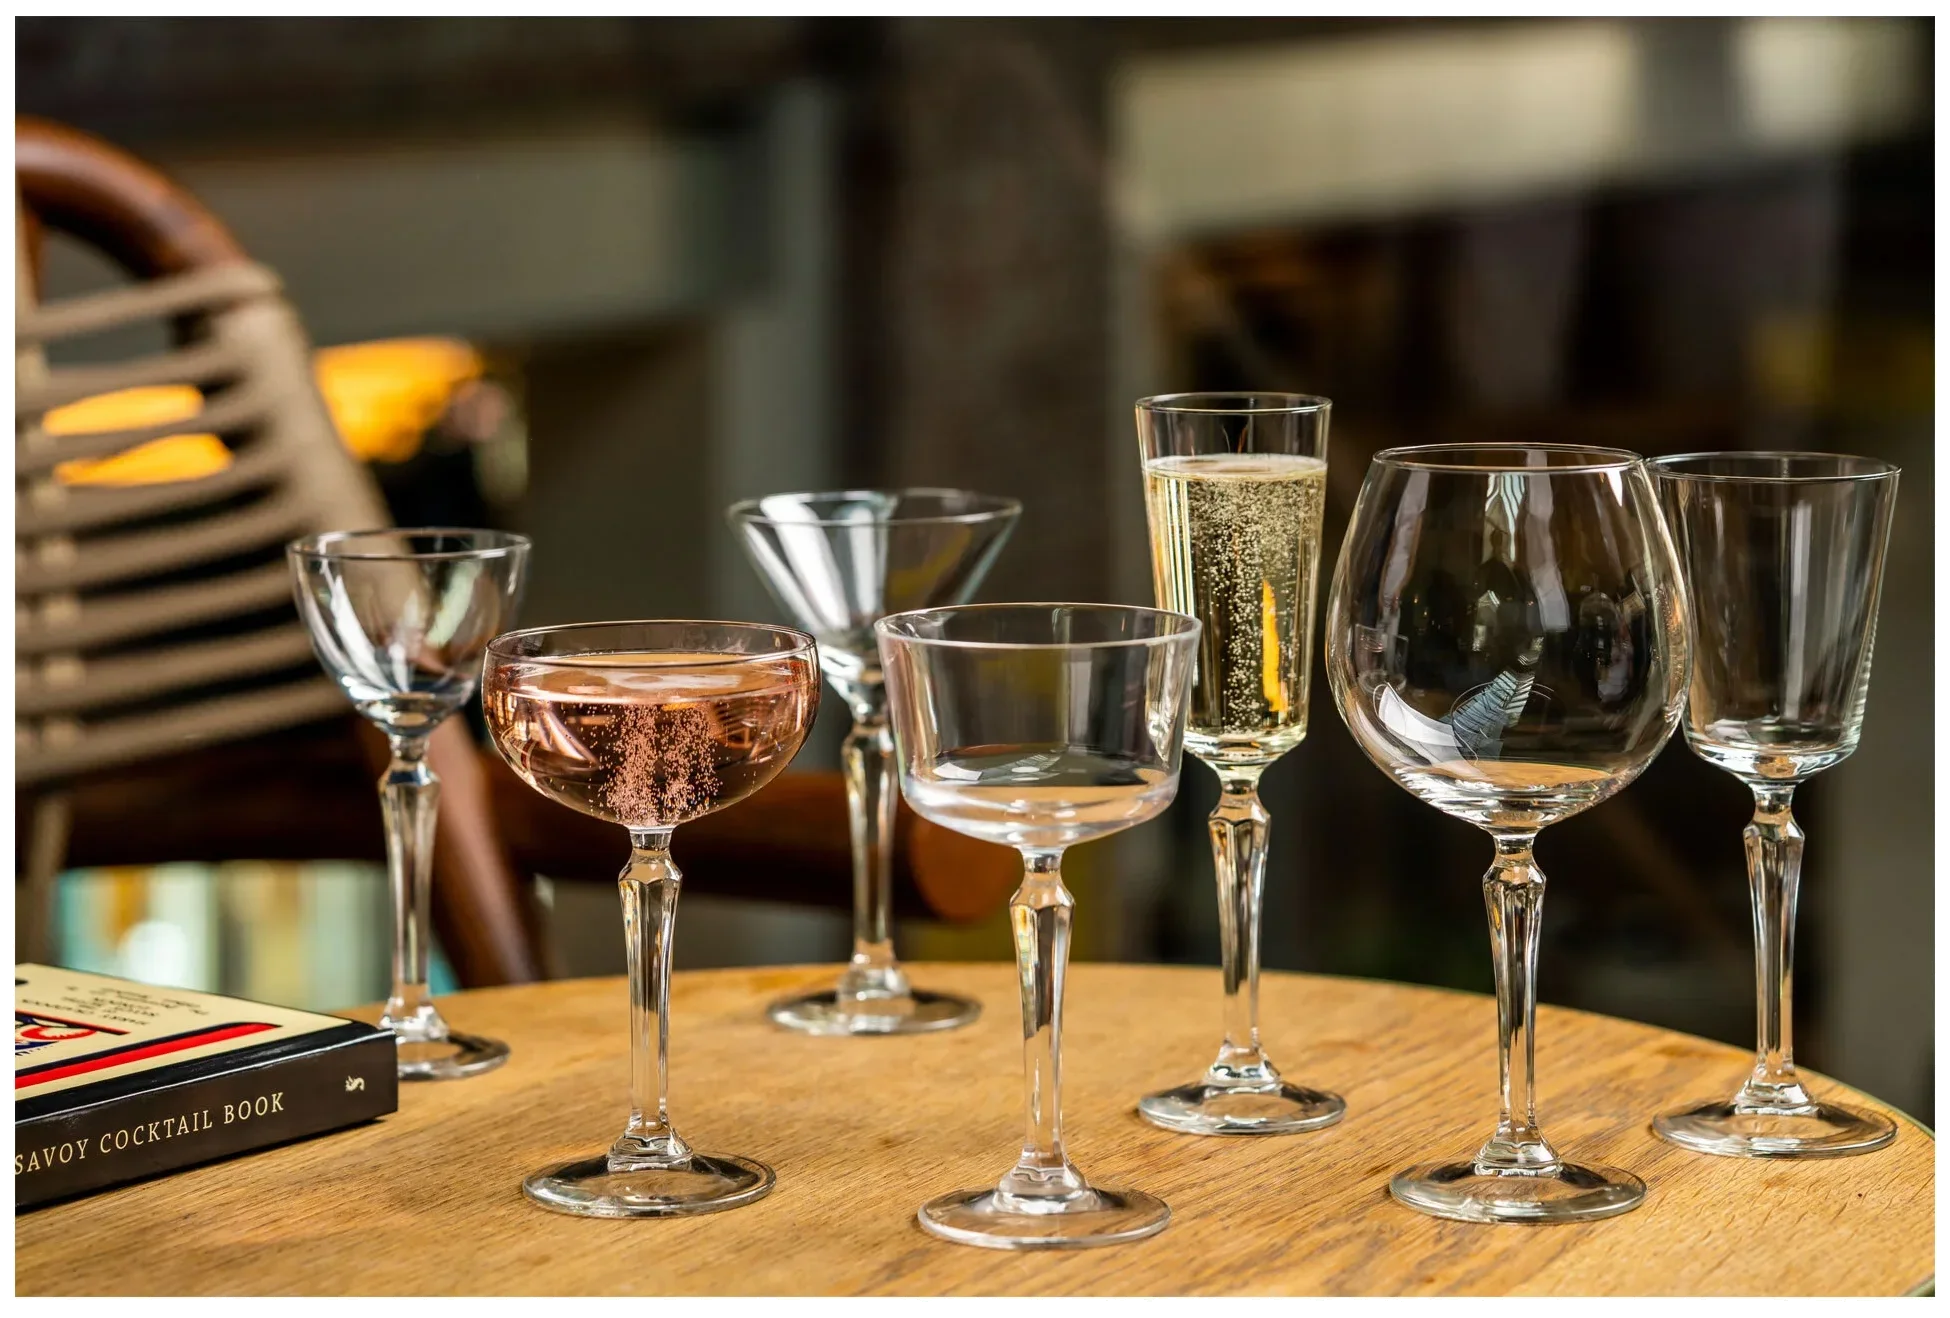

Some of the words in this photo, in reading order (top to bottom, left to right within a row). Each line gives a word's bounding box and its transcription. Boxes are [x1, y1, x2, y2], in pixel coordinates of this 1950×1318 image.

[14, 1138, 89, 1176] SAVOY
[100, 1109, 213, 1154] COCKTAIL
[223, 1091, 284, 1125] BOOK
